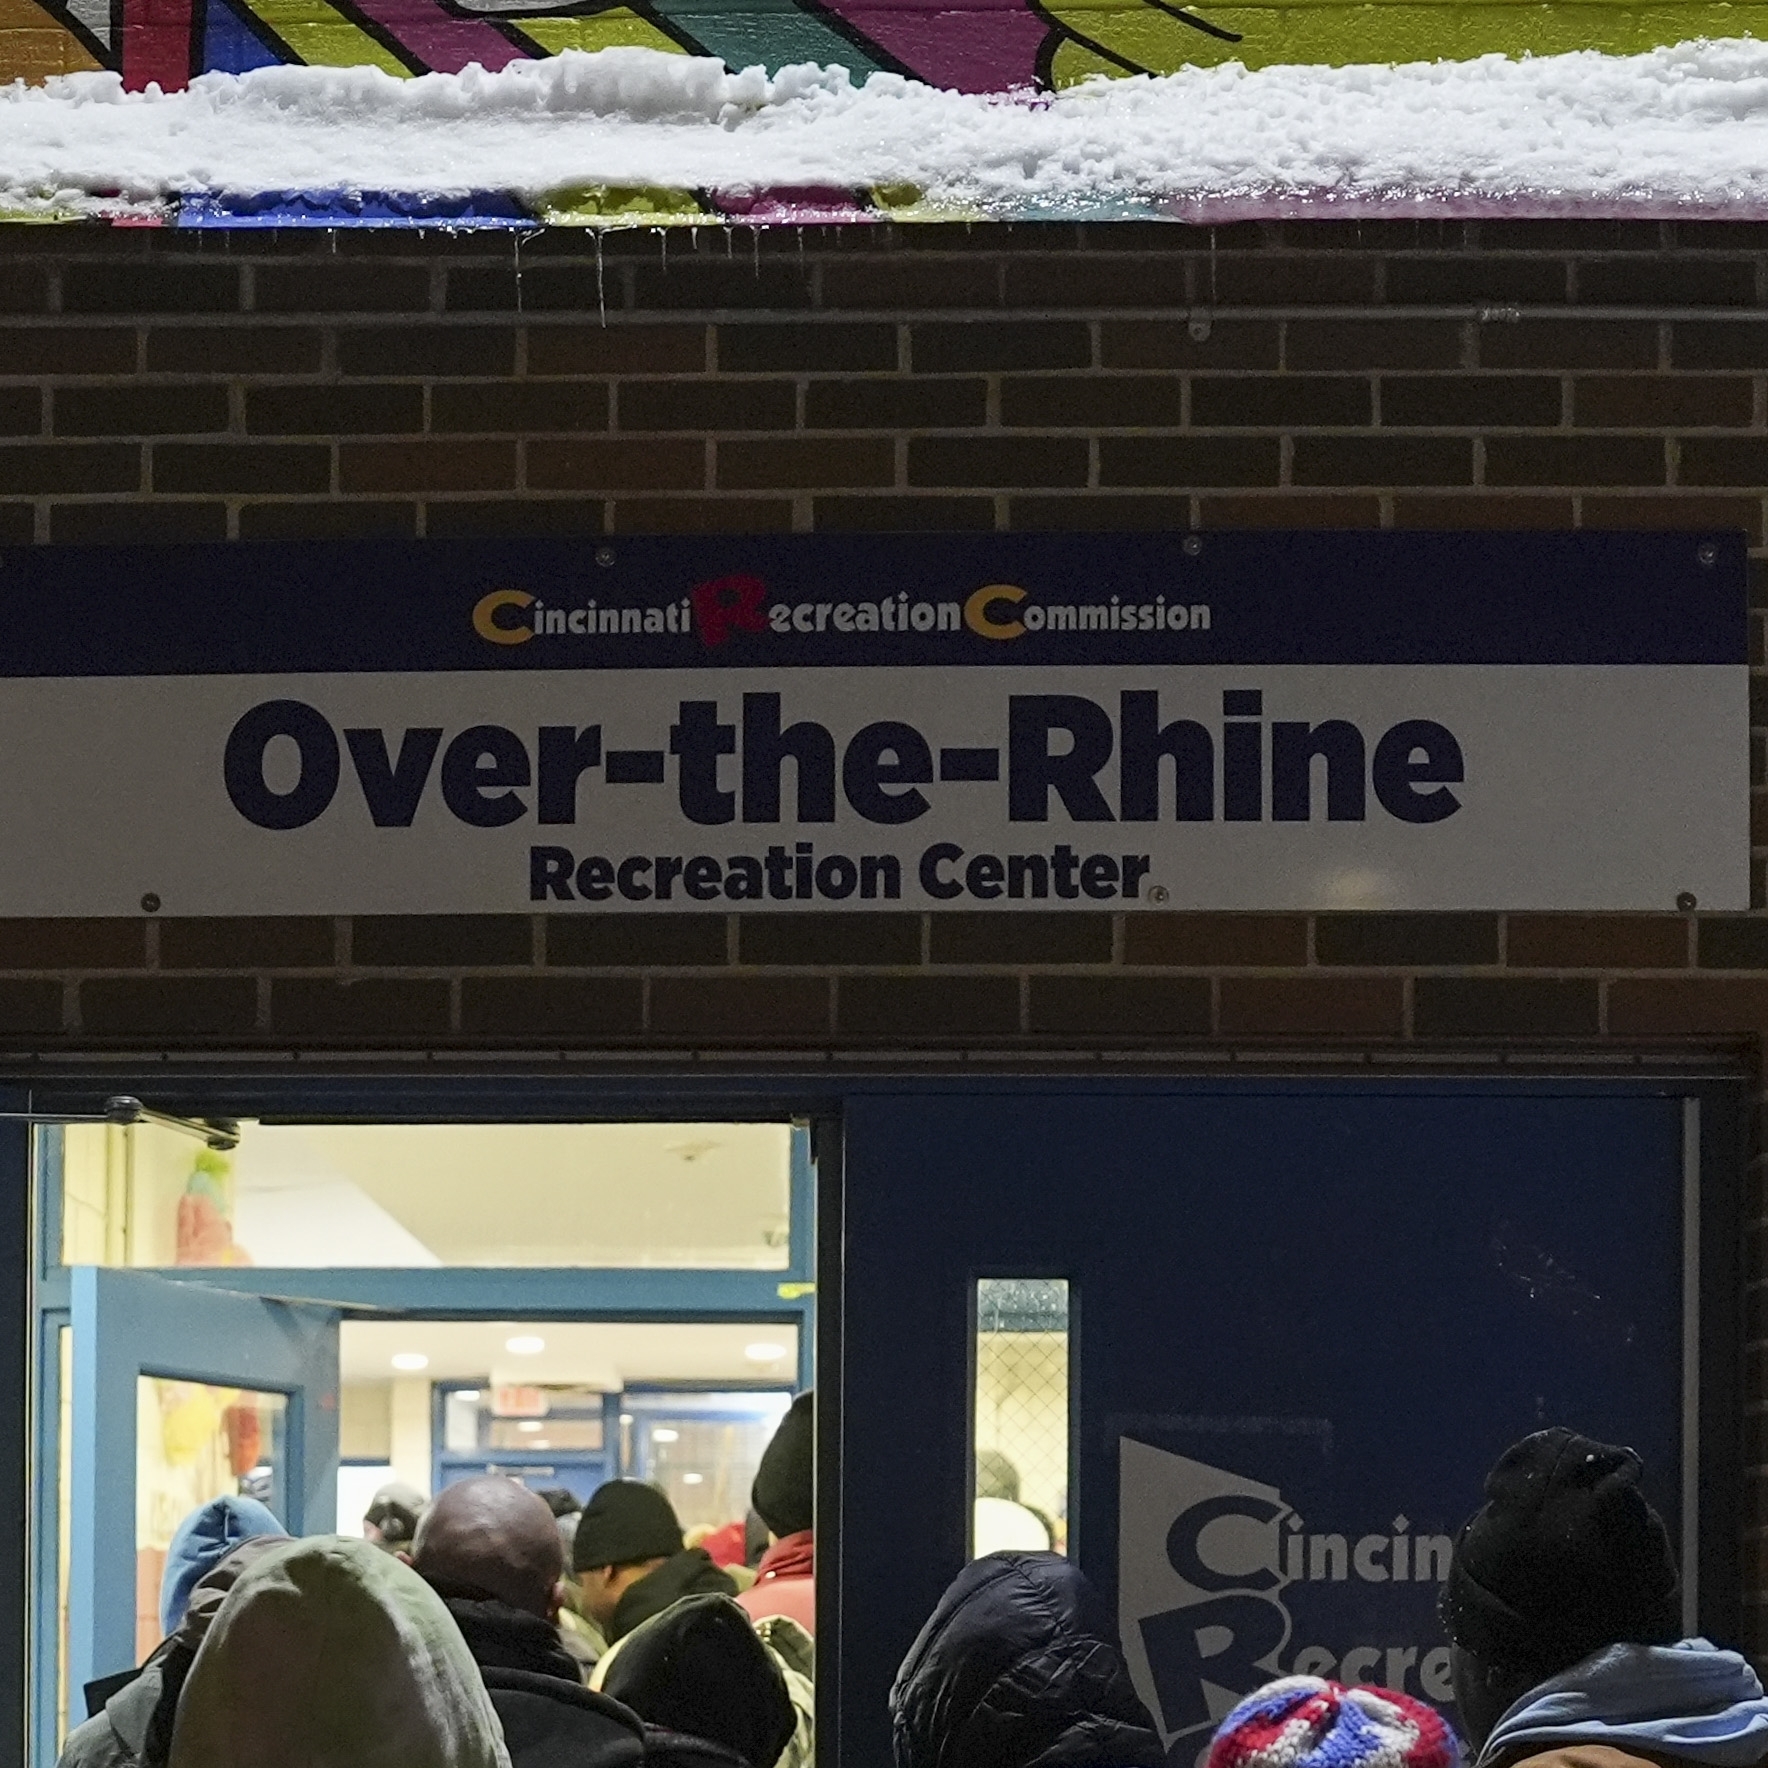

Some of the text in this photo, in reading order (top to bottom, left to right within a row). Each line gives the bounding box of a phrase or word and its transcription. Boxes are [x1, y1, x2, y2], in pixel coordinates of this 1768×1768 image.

[471, 573, 1212, 648] Cincinnati Recreation Commission
[224, 690, 1465, 830] Over-the-Rhine
[530, 842, 1151, 901] Recreation Center
